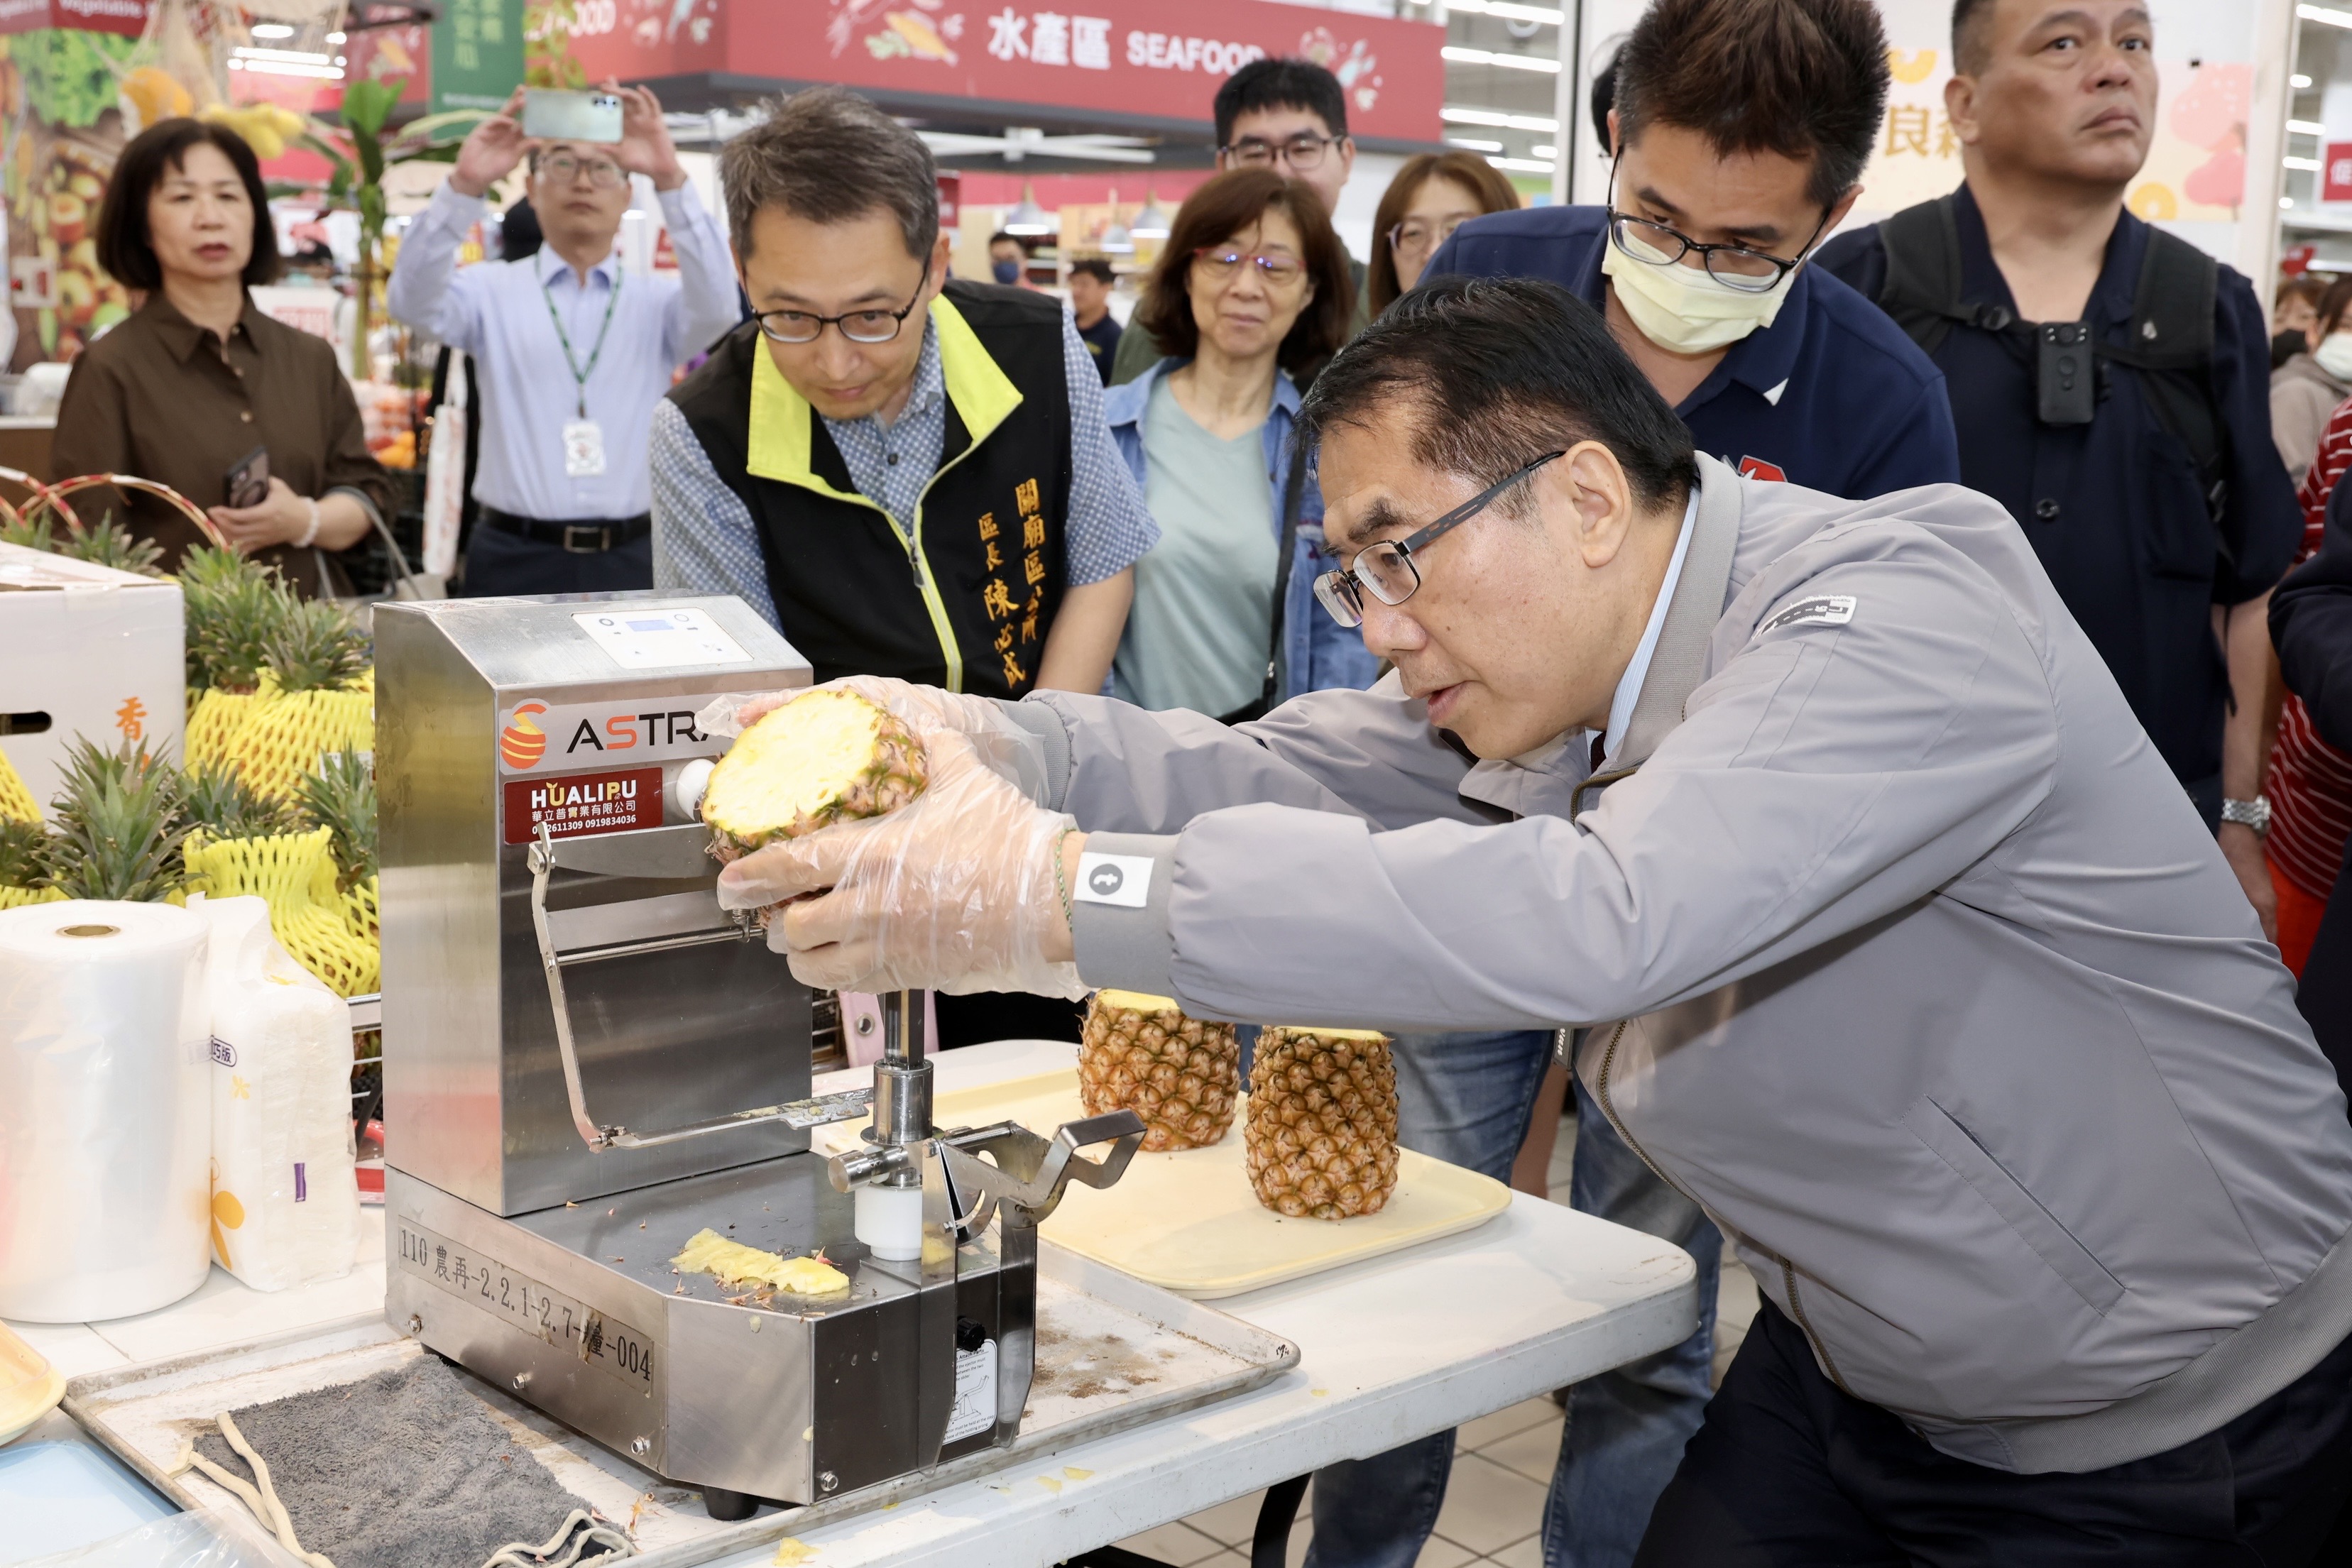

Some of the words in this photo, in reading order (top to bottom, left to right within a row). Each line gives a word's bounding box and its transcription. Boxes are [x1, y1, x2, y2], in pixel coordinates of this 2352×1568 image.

[988, 6, 1112, 70] 水產區
[116, 696, 147, 742] 香
[567, 710, 732, 754] ASTR
[532, 780, 636, 809] HUALIPU
[585, 814, 636, 829] 0919834036
[402, 1229, 427, 1266] 110
